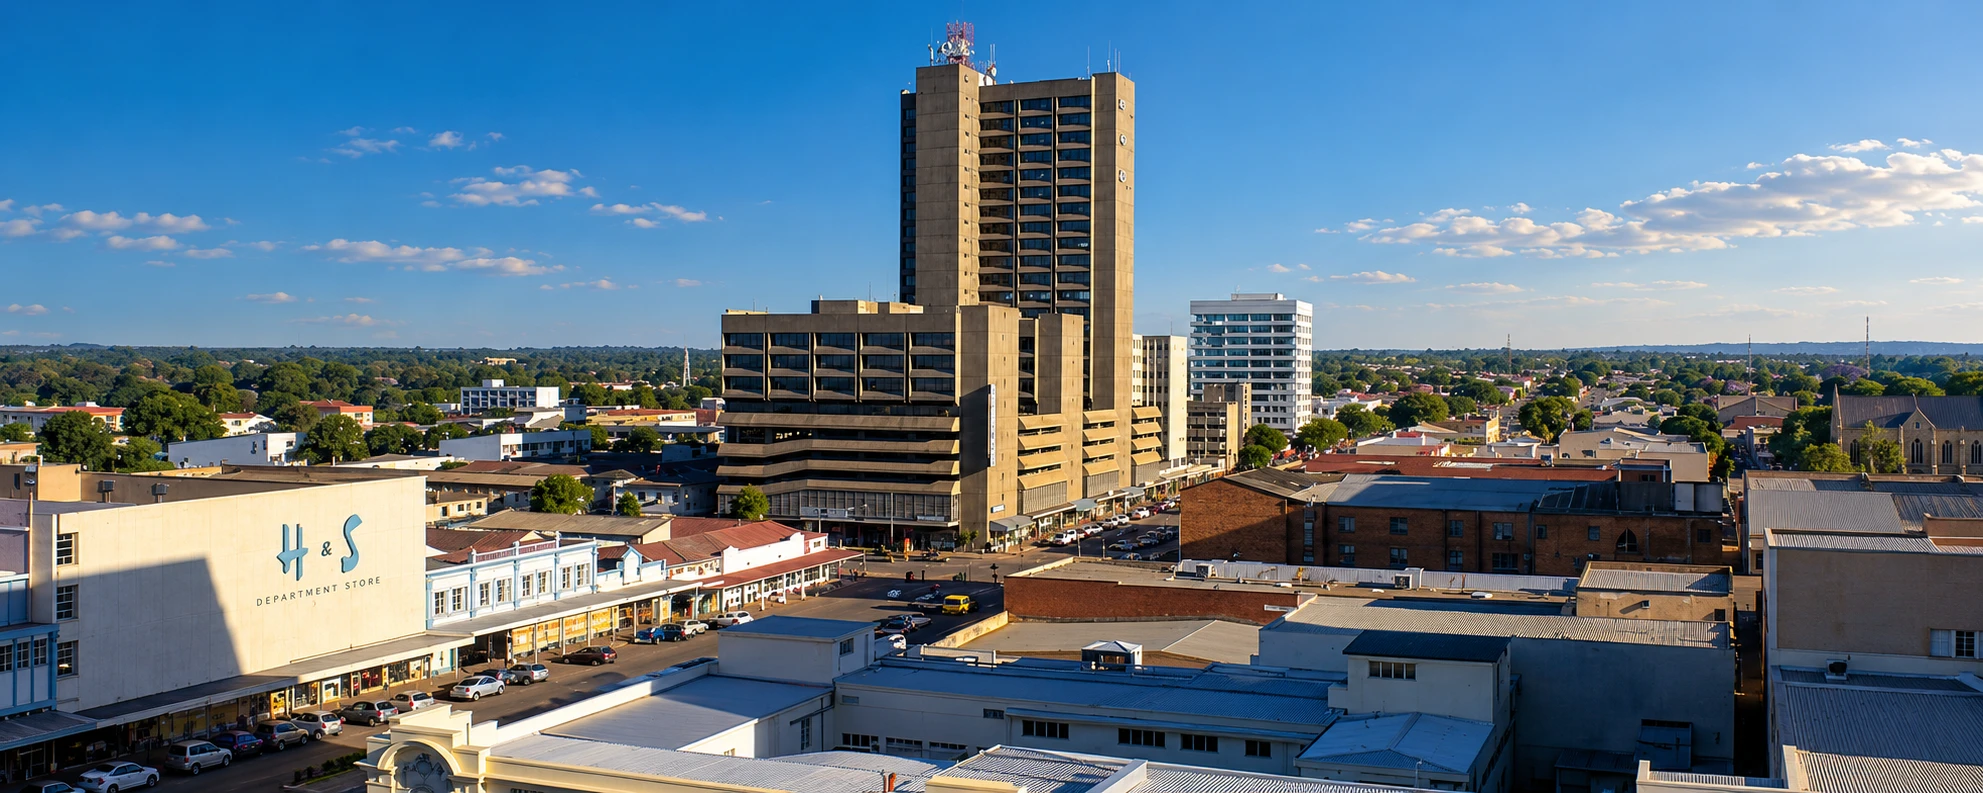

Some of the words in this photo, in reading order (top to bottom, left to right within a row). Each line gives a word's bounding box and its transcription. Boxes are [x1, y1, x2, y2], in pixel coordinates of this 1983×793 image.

[276, 523, 309, 581] H
[321, 541, 332, 556] &
[341, 513, 363, 573] S
[256, 584, 338, 606] DEPARTMENT
[345, 576, 380, 590] STORE
